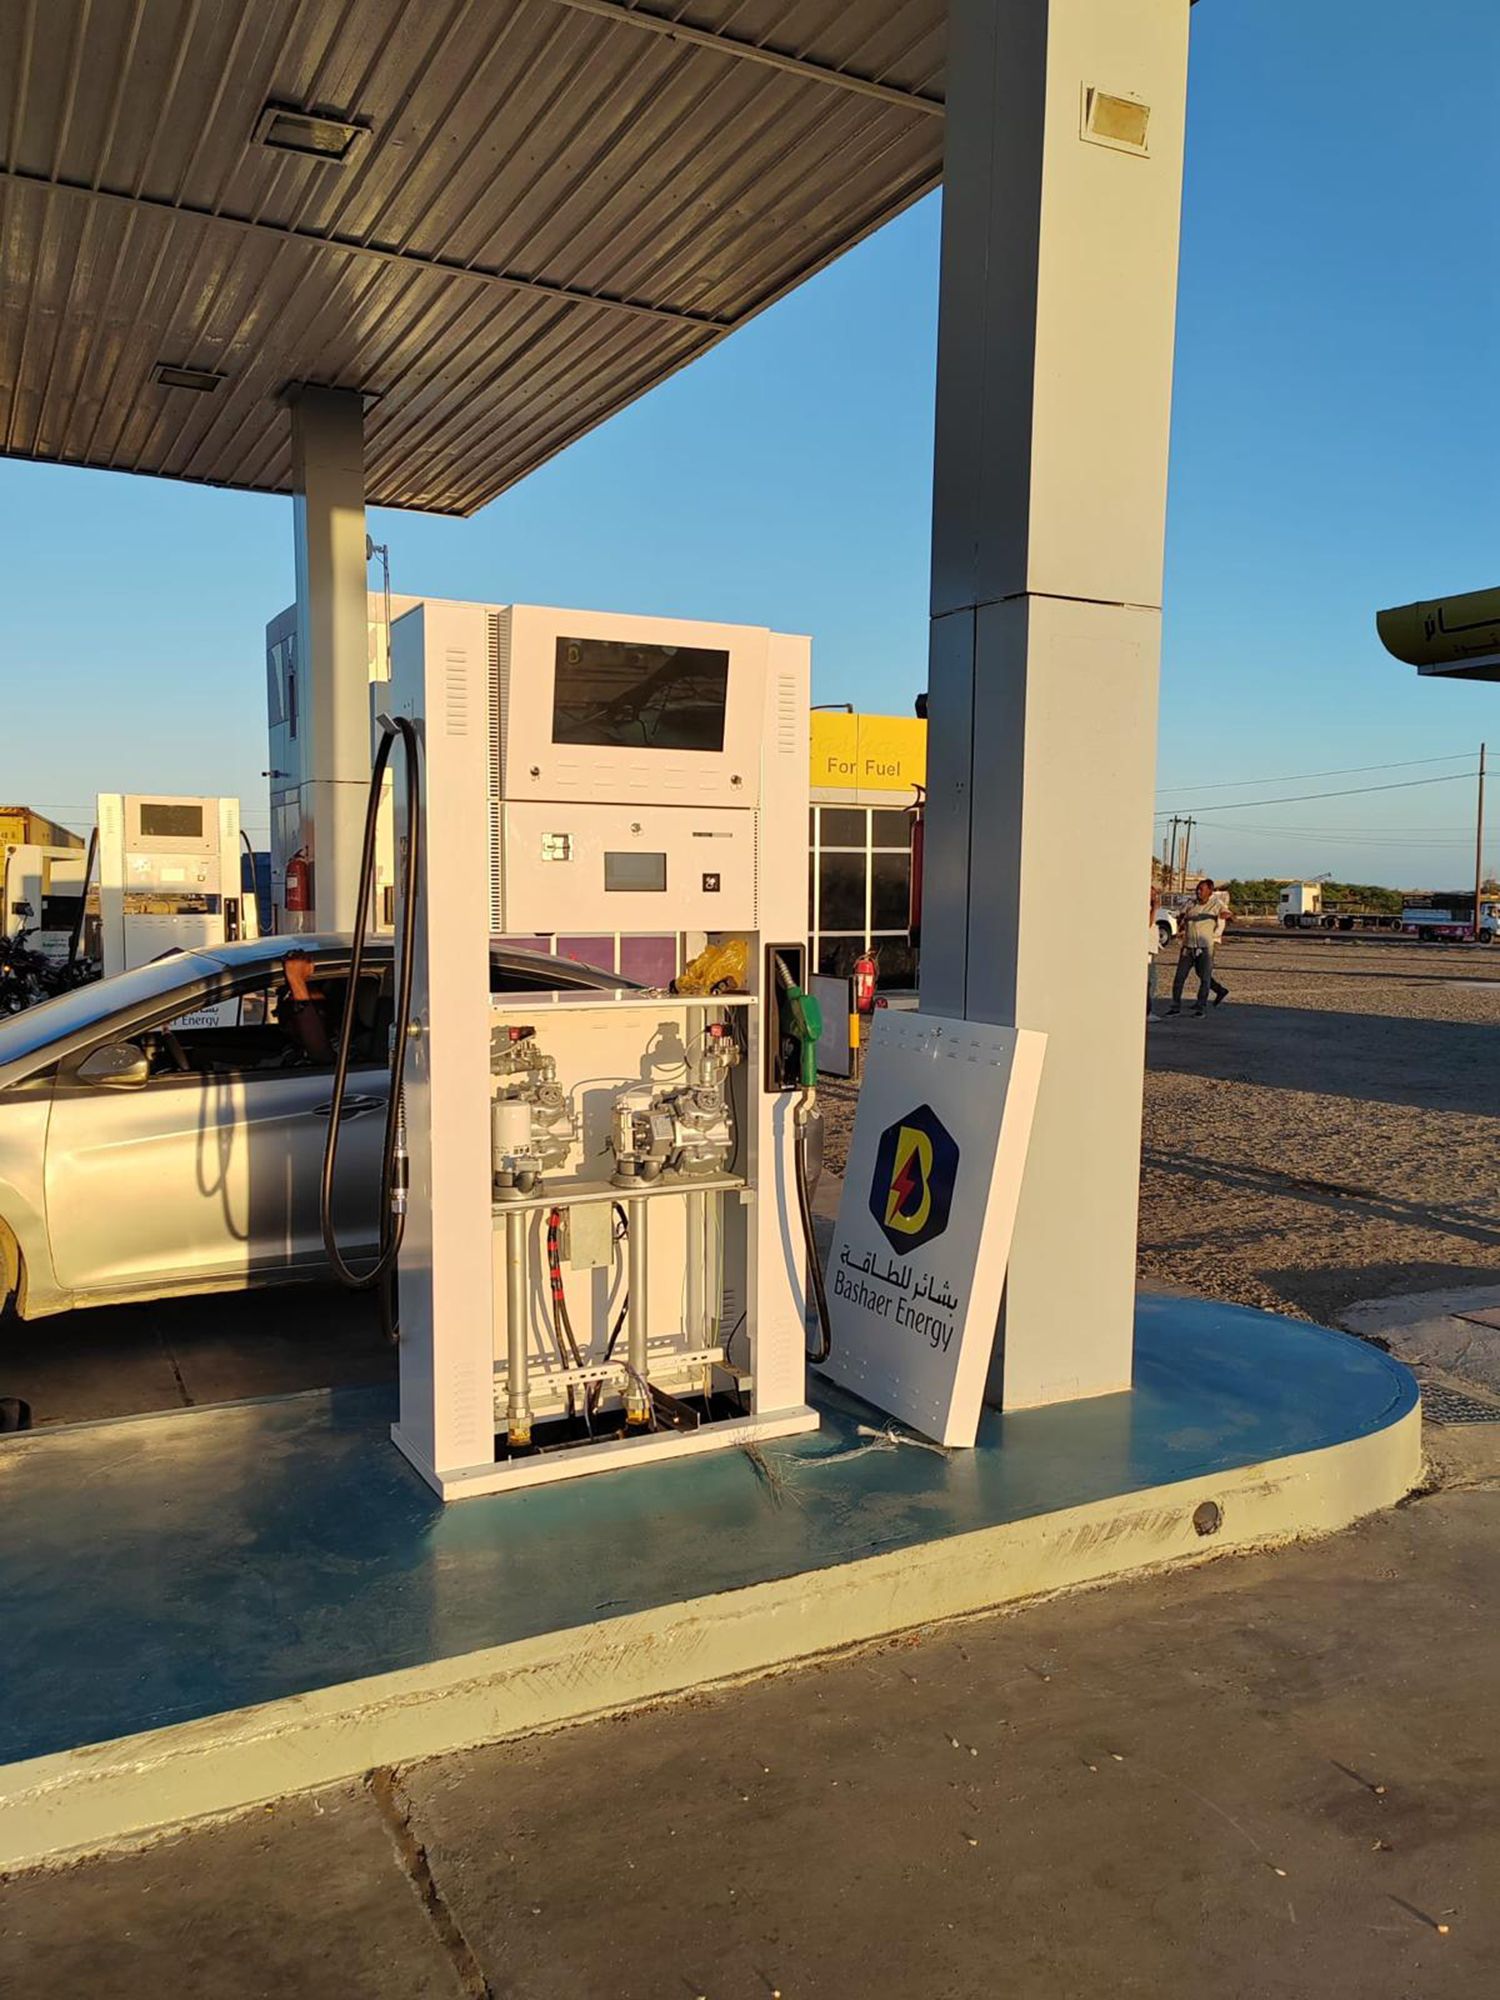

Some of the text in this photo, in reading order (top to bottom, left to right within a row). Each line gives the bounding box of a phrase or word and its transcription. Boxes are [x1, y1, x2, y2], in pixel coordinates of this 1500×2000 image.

[827, 757, 901, 776] For Fuel
[834, 1270, 954, 1352] Bashaer Energy
[840, 1244, 958, 1318] بشائر للطاقة
